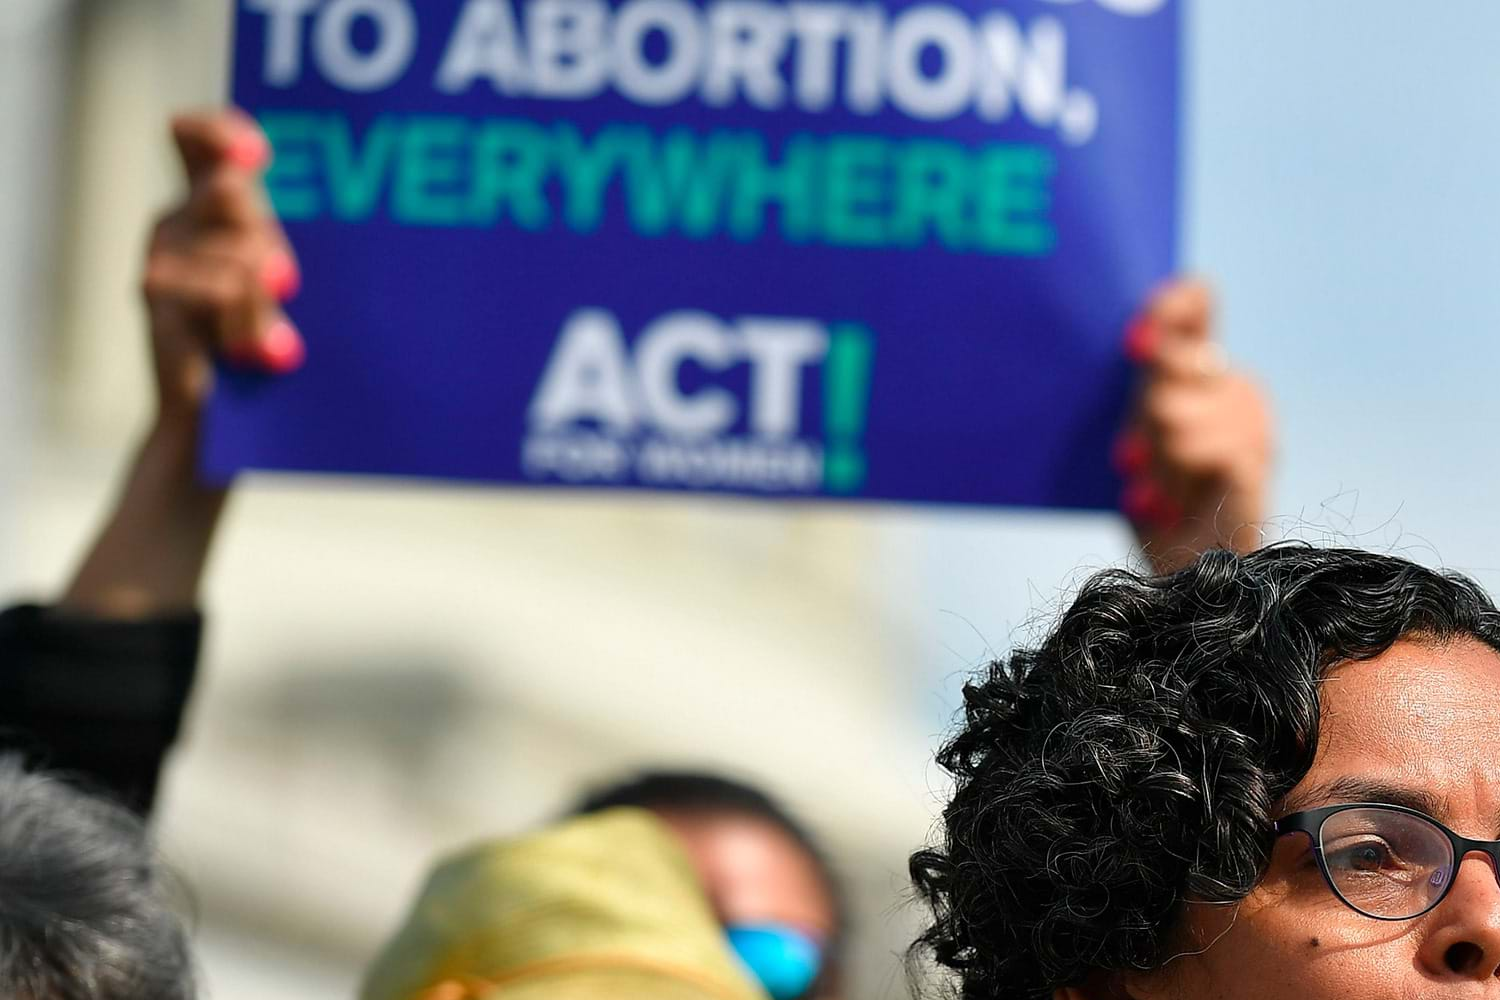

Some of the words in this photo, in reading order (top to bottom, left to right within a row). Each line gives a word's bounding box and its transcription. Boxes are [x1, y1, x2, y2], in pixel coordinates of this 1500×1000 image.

[242, 0, 418, 93] TO
[434, 0, 1097, 146] ABORTION,
[258, 110, 1054, 254] EVERYWHERE
